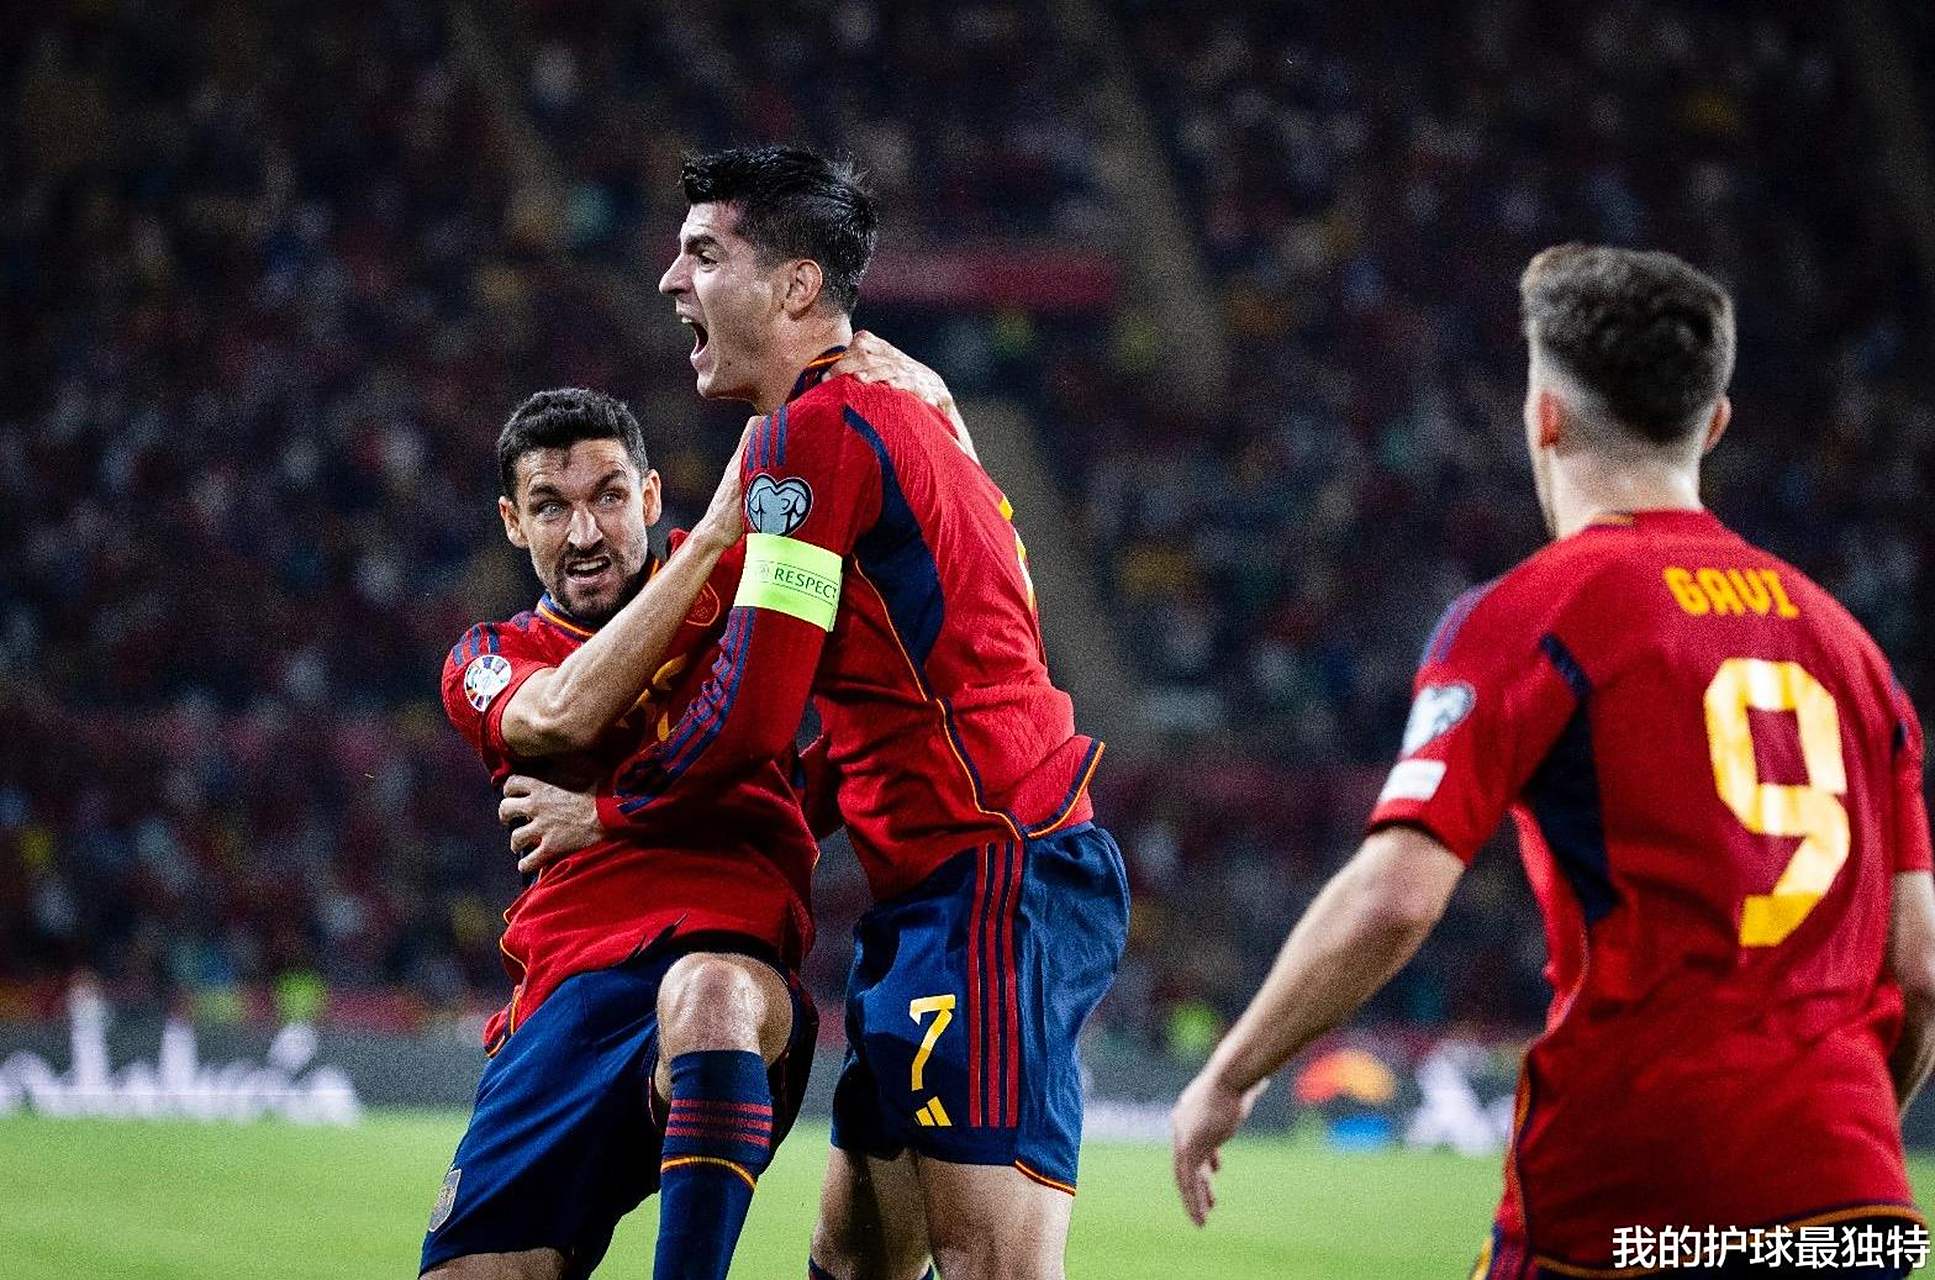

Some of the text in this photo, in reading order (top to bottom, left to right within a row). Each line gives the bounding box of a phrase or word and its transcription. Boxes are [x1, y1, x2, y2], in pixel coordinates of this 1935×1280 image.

[1664, 567, 1800, 619] GAVI
[1703, 657, 1850, 947] 9
[909, 994, 956, 1091] 7
